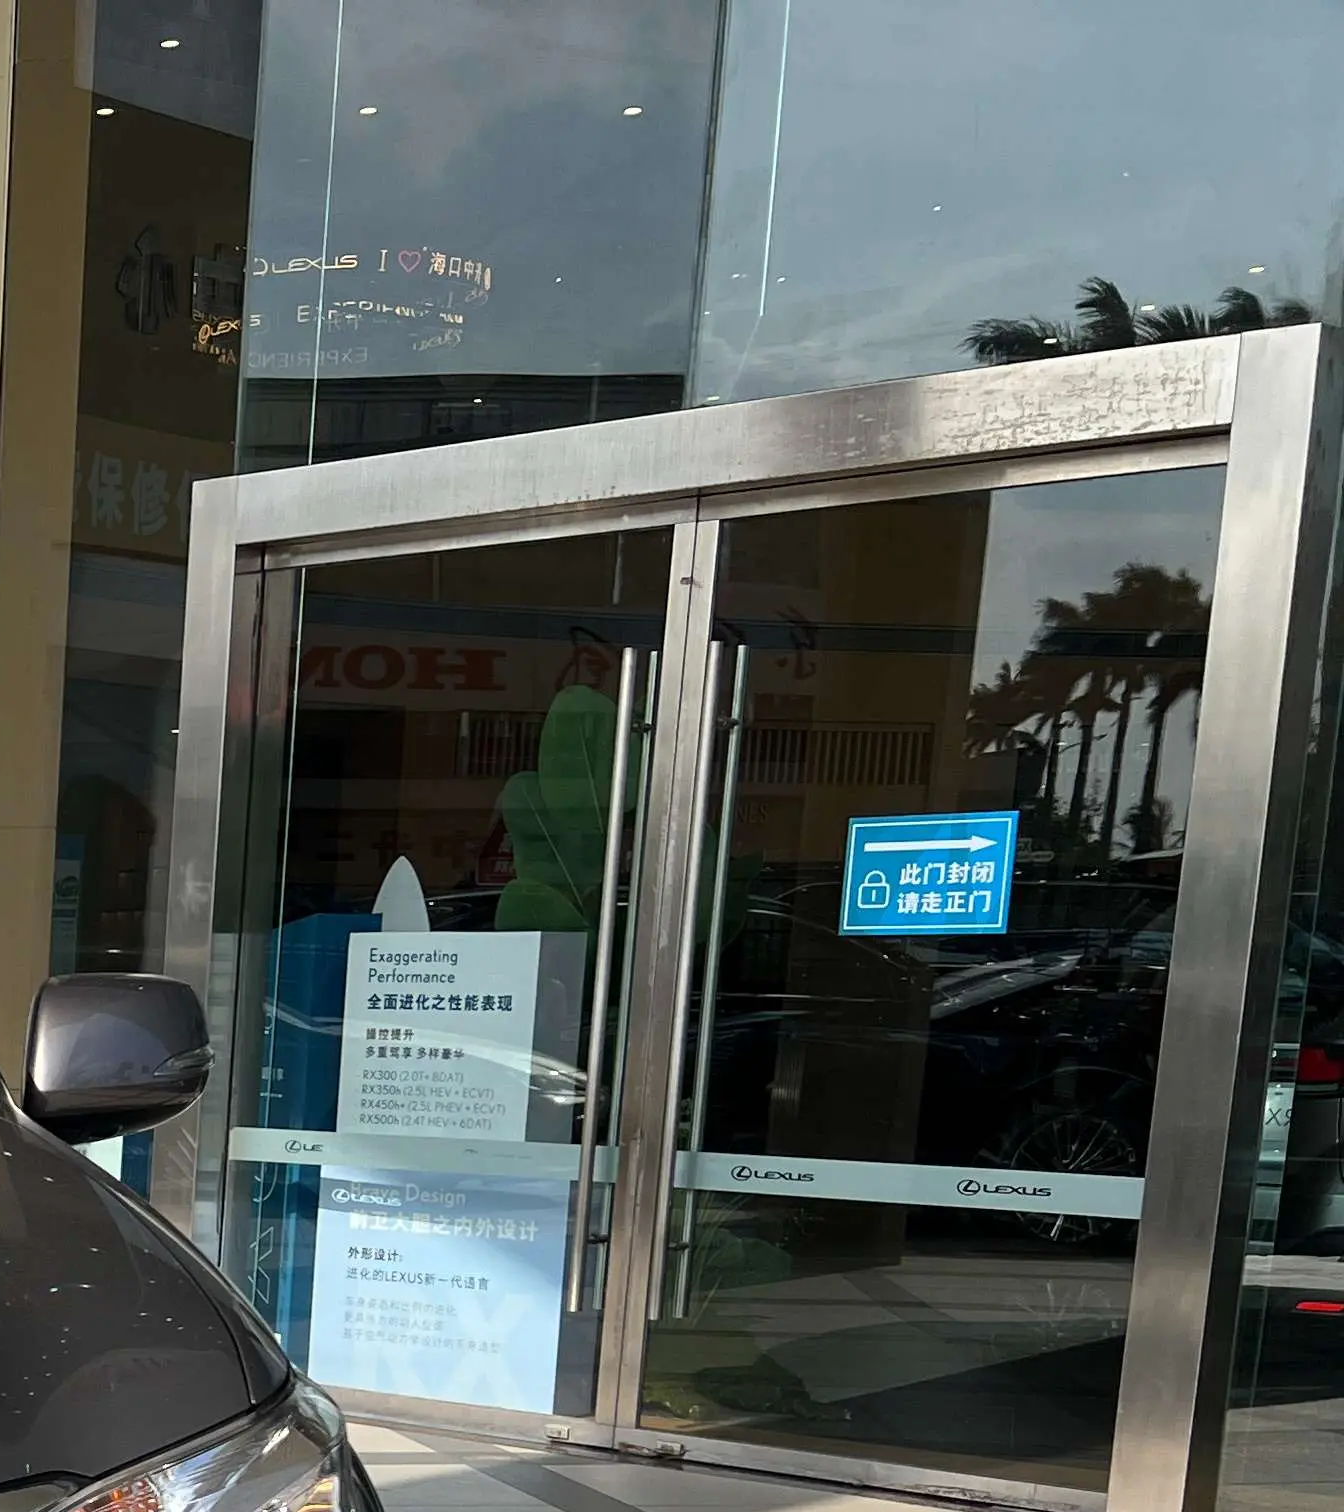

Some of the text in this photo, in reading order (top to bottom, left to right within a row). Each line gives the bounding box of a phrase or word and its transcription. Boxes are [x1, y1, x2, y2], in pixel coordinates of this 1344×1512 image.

[898, 861, 996, 886] 此门封闭
[897, 890, 992, 914] 请走正门
[368, 947, 459, 966] Exaggerating
[368, 968, 456, 984] Performance
[367, 993, 513, 1013] 全面进化之性能表现
[362, 1069, 398, 1081] RX300
[754, 1169, 814, 1183] LEXUS
[405, 1183, 466, 1209] Design
[983, 1184, 1052, 1198] LEXUS
